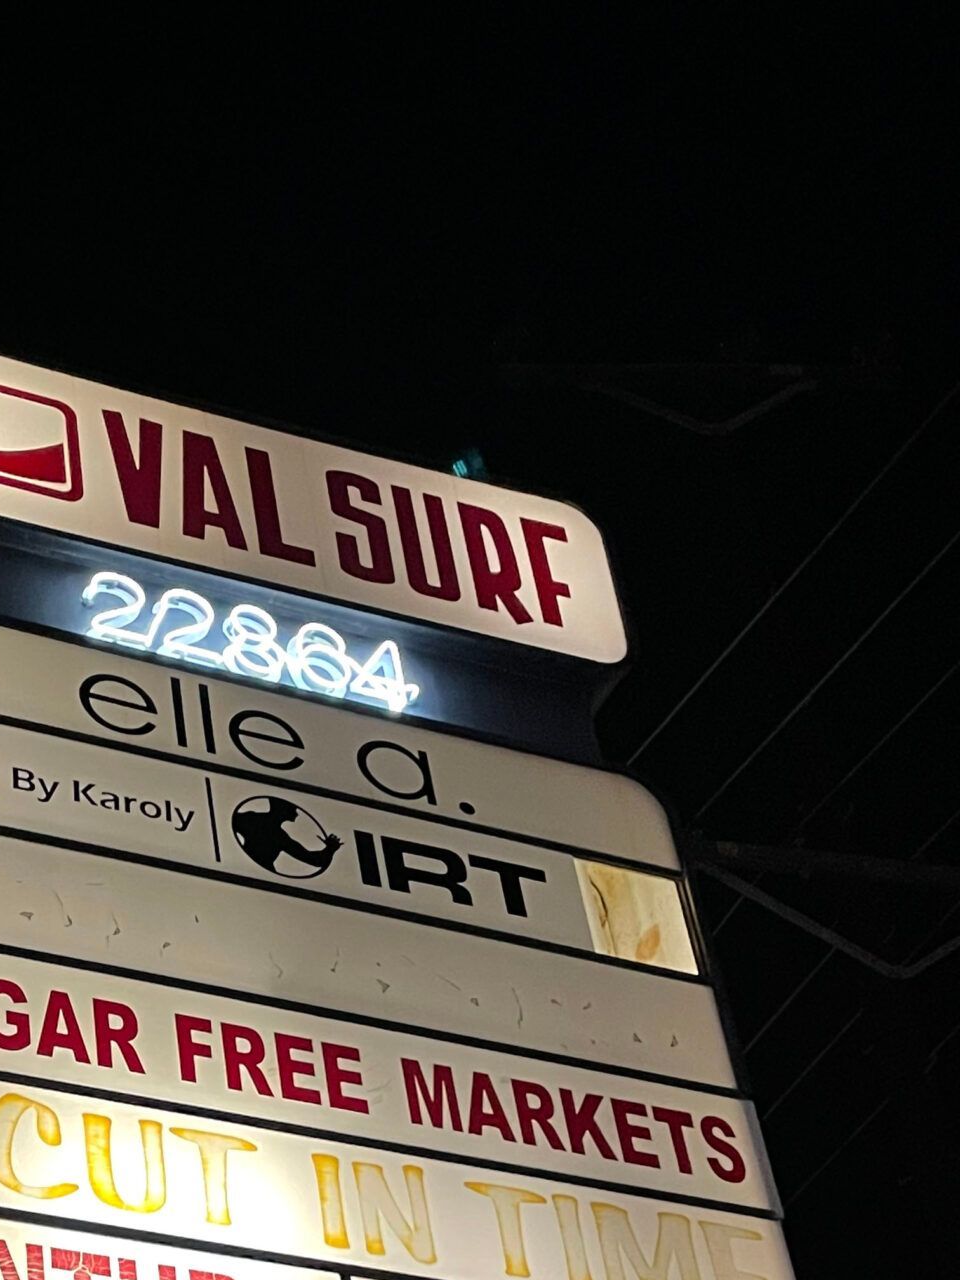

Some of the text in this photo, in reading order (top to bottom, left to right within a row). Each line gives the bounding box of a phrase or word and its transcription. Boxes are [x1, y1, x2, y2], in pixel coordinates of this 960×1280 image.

[102, 409, 571, 628] VAL SURF
[82, 571, 420, 712] 22864
[12, 767, 59, 802] By
[73, 780, 195, 831] Karoly
[79, 674, 475, 815] elle a.
[353, 830, 547, 918] IRT
[174, 1013, 370, 1115] FREE
[400, 1057, 747, 1184] MARKETS
[311, 1153, 437, 1265] IN
